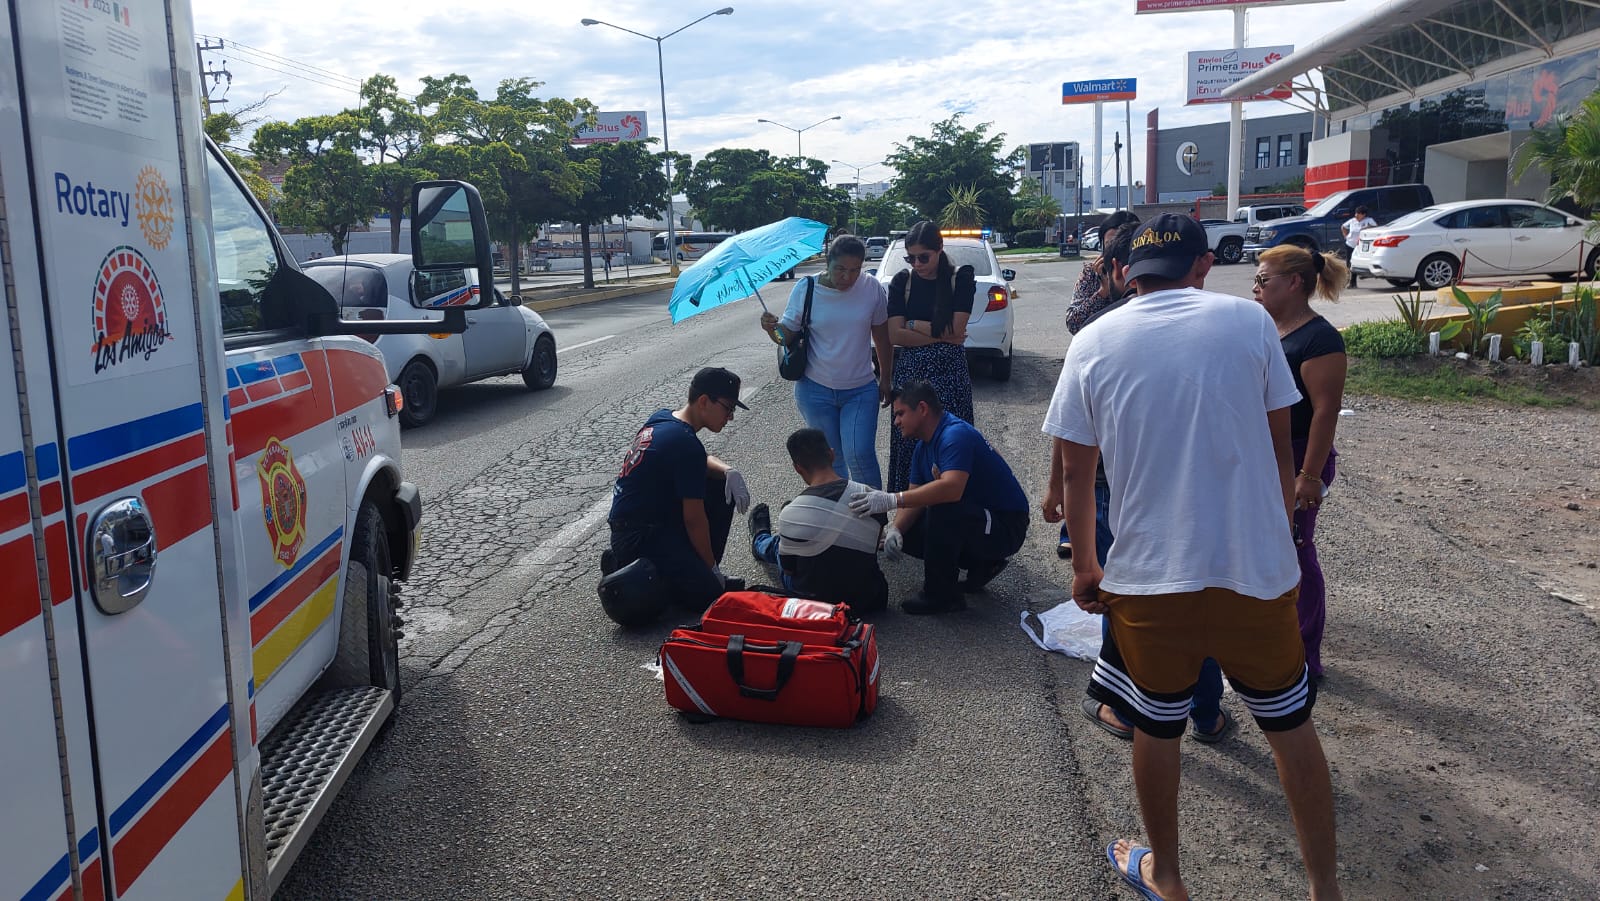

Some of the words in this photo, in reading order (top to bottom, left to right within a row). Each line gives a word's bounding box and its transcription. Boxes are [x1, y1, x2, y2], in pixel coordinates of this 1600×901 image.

[1198, 63, 1238, 72] Primera
[1241, 61, 1264, 69] Plus
[1073, 81, 1116, 93] Walmart
[597, 124, 620, 132] Plus
[55, 172, 130, 227] Rotary
[1132, 231, 1181, 250] SINALOA
[95, 331, 117, 375] Los
[119, 318, 171, 363] Amigos
